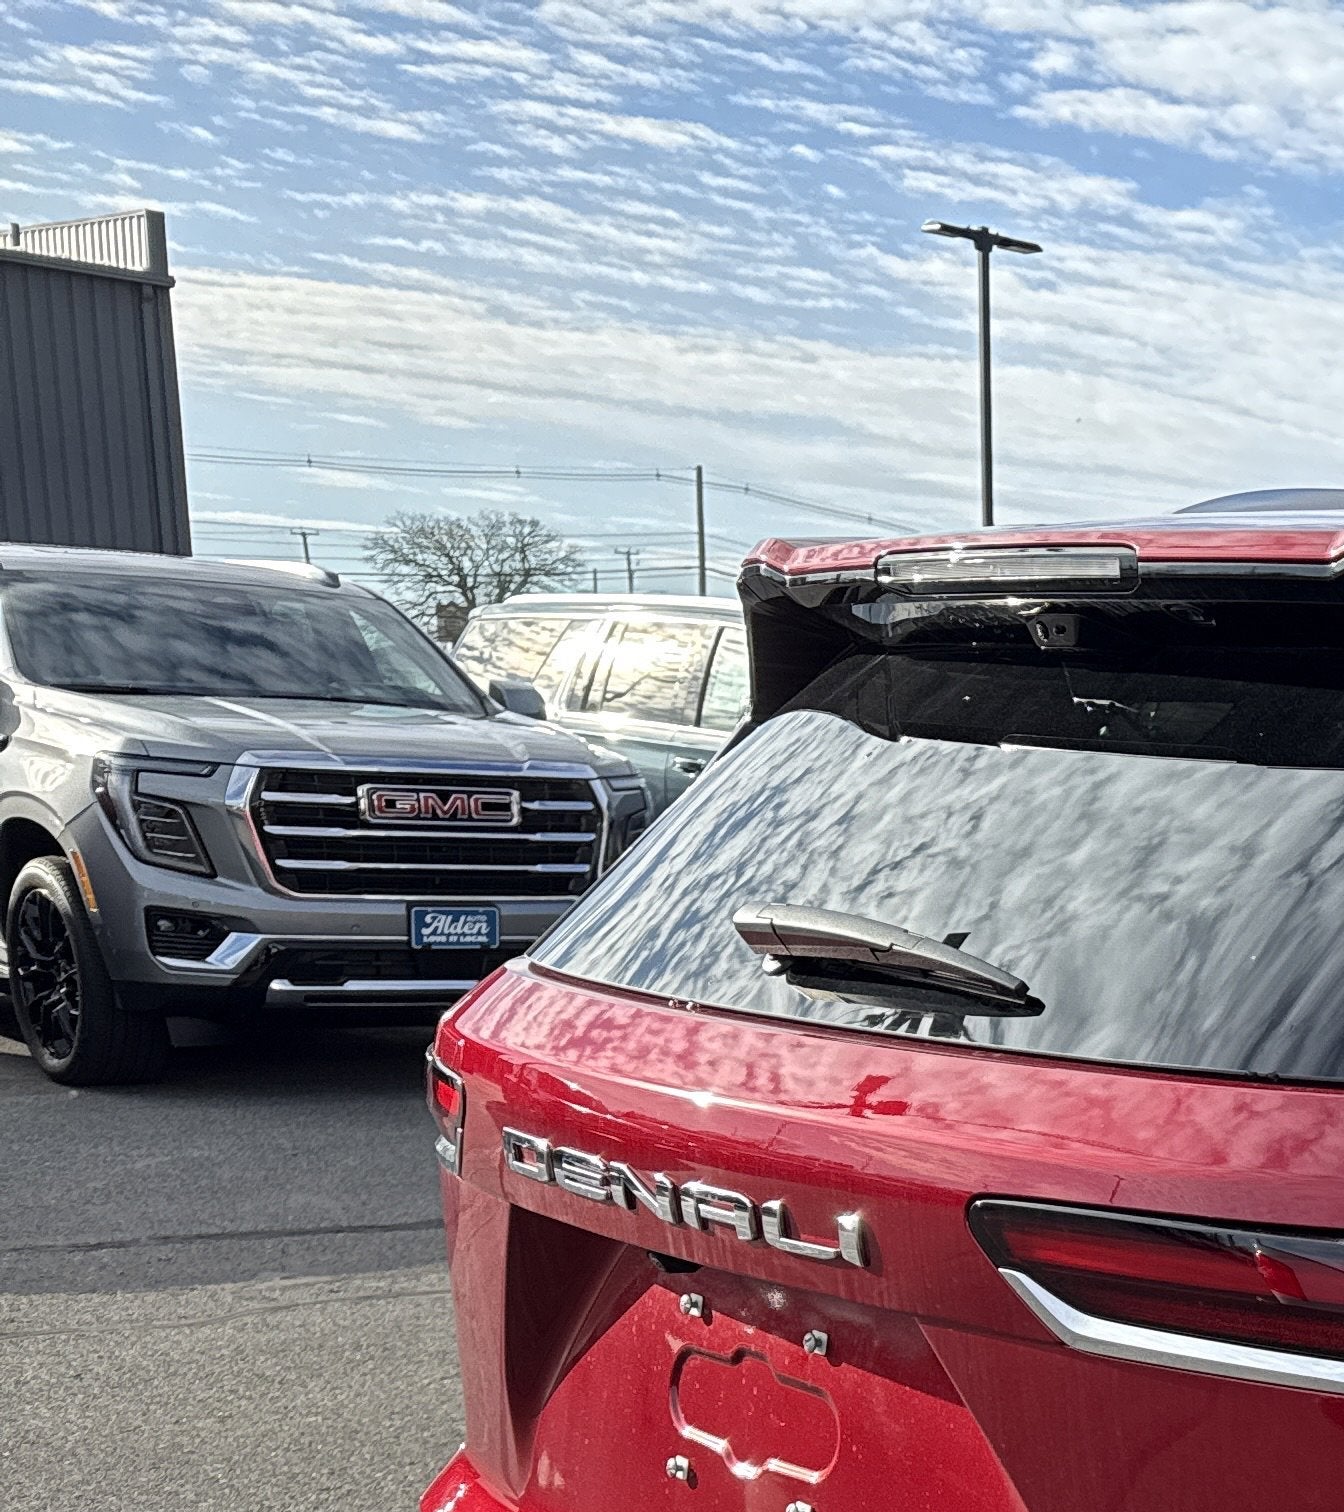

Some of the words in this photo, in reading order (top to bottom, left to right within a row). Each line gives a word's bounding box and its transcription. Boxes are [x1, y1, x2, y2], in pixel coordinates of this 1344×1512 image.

[372, 791, 513, 819] GMC
[421, 912, 491, 935] Alden
[503, 1126, 872, 1268] DENALI
